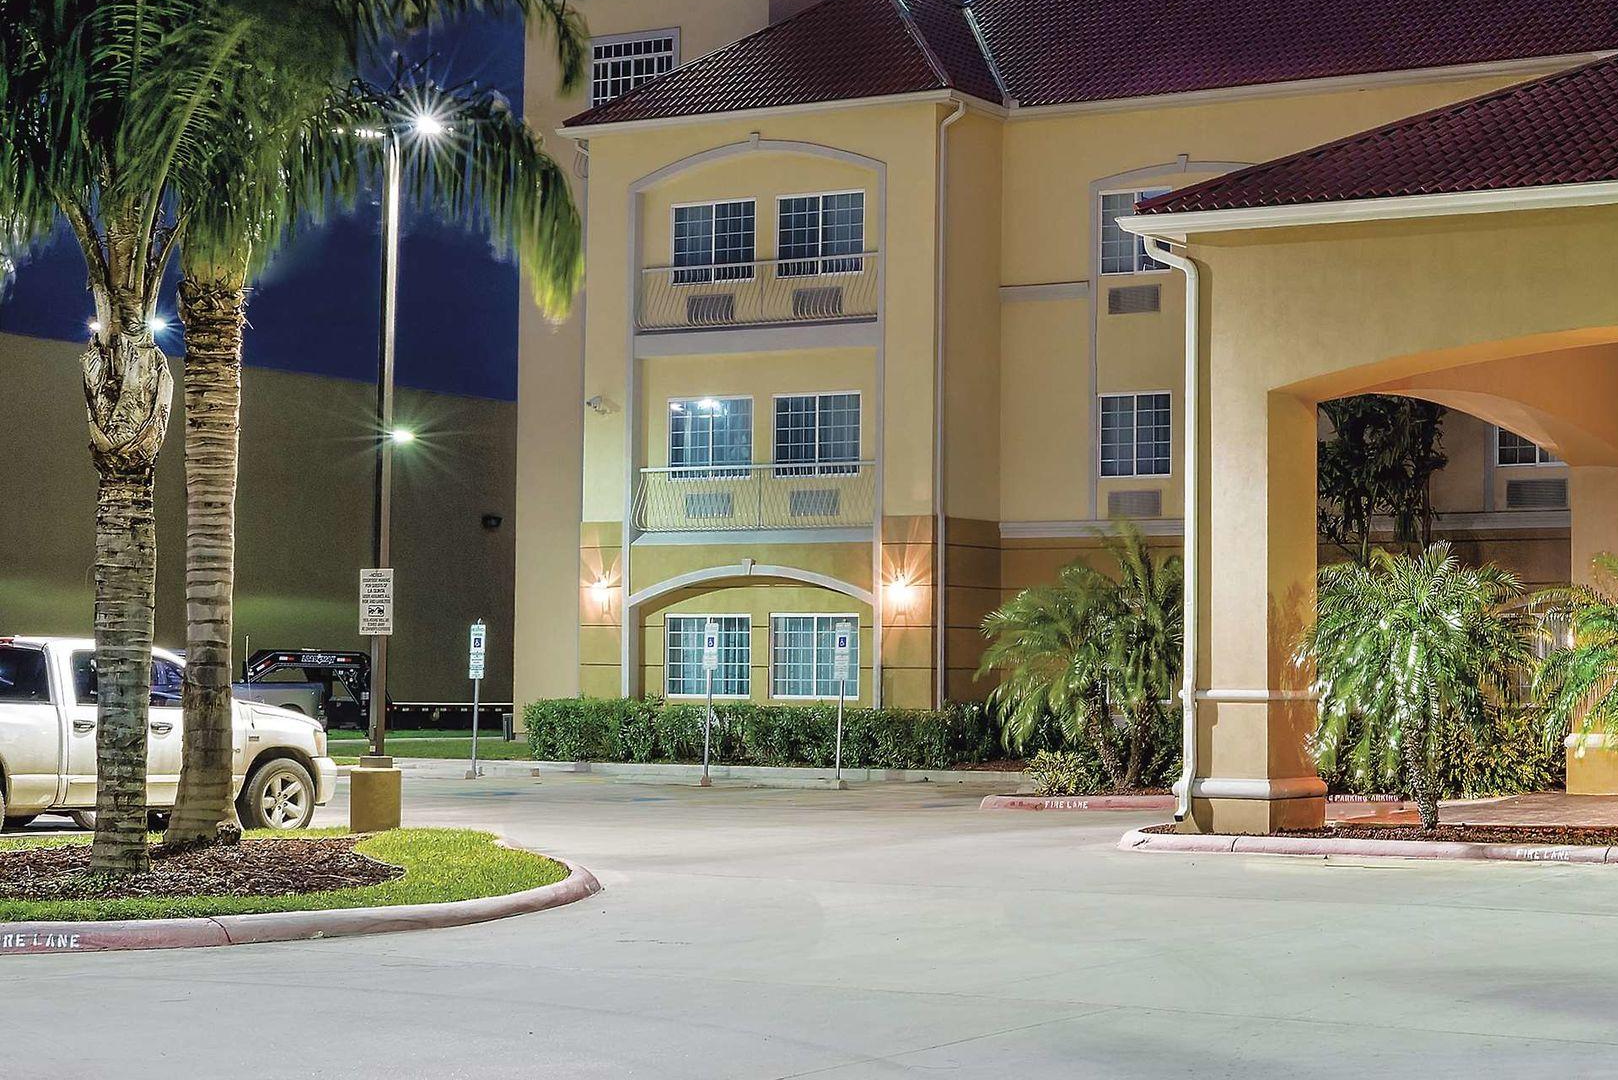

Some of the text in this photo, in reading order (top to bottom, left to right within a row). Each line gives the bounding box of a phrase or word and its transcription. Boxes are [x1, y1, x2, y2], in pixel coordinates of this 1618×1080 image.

[1044, 800, 1088, 809] FIRE LANE
[0, 933, 80, 948] RE LANE
